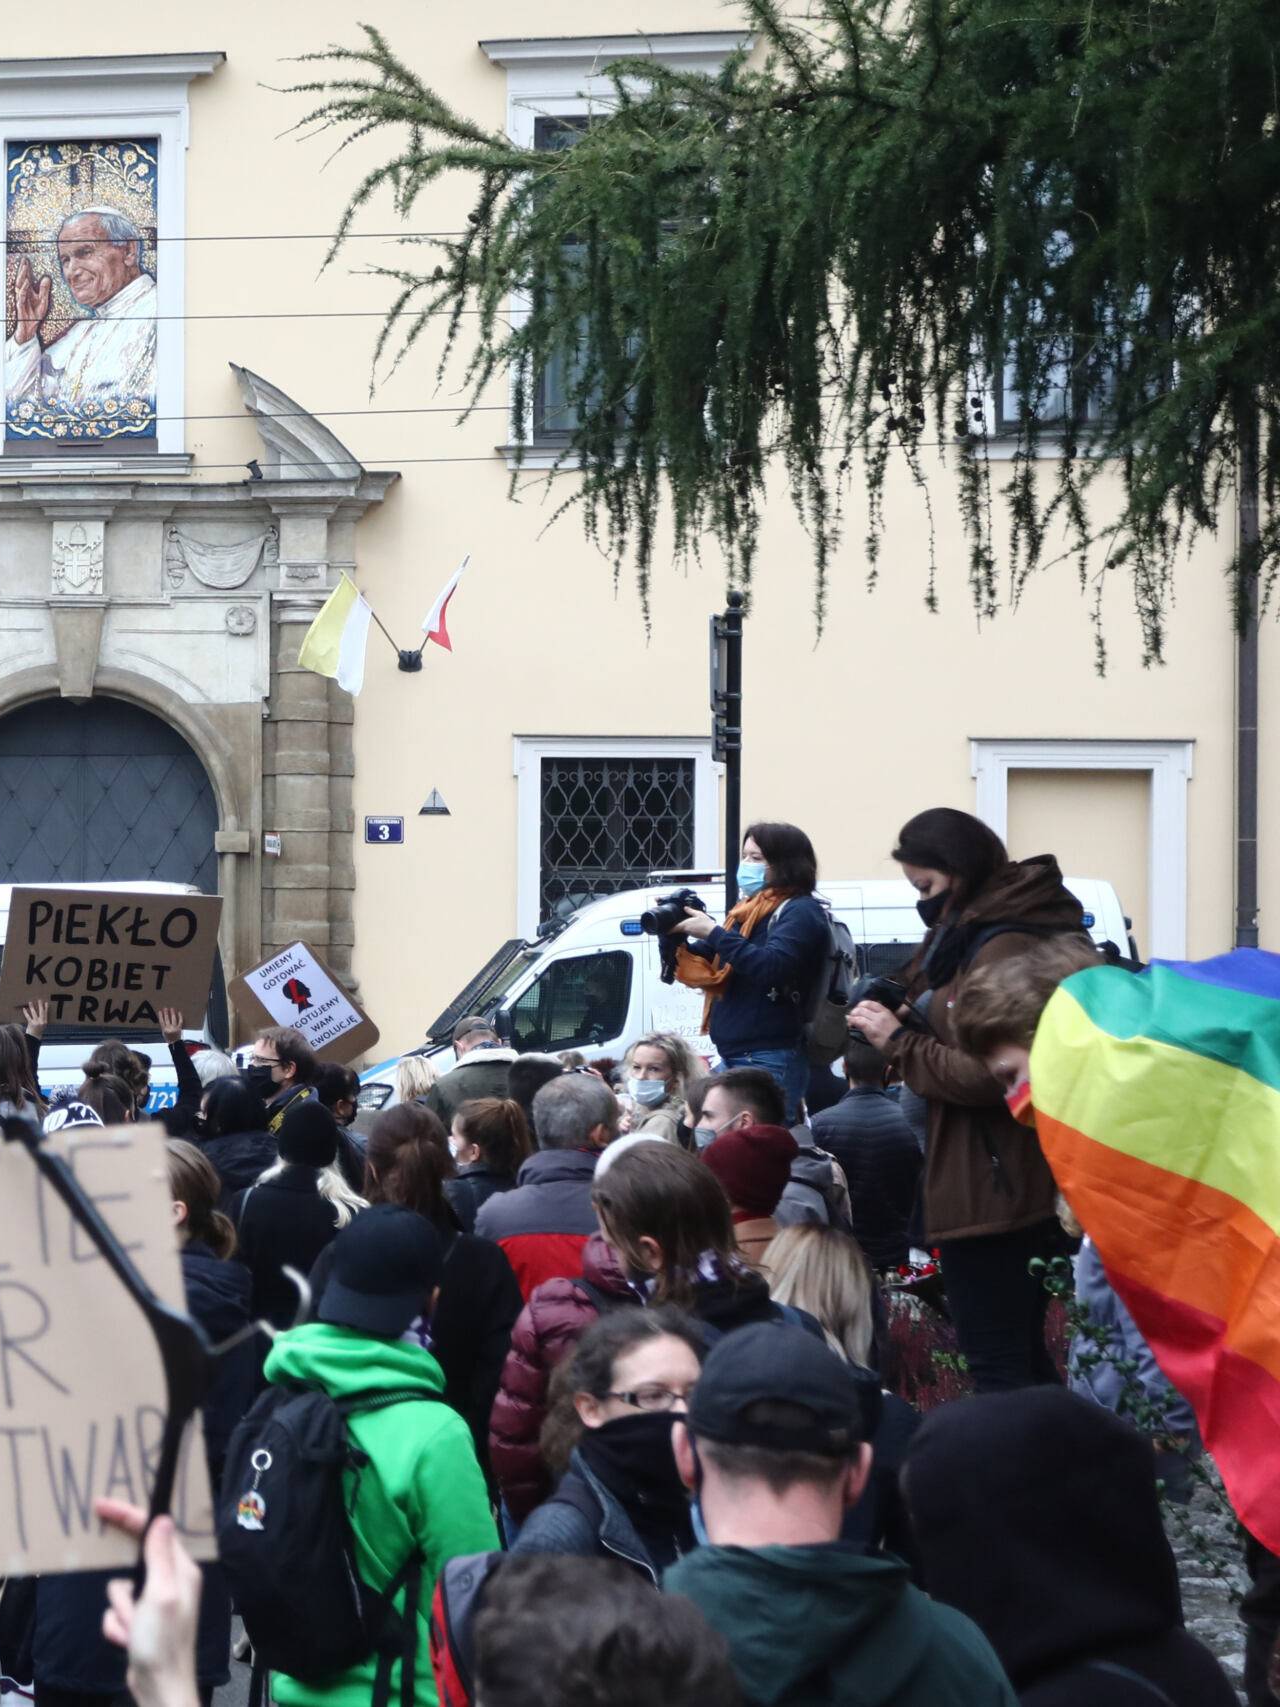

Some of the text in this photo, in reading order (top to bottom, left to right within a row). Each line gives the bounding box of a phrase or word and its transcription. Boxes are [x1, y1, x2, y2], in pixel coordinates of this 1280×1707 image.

[378, 824, 390, 840] 3
[28, 900, 198, 949] PIEKŁO
[25, 953, 172, 992] KOBIET
[259, 952, 294, 979] UMIEMY
[263, 959, 307, 991] GOTOWAĆ
[50, 994, 160, 1024] TRWA
[310, 1015, 334, 1032] WAM
